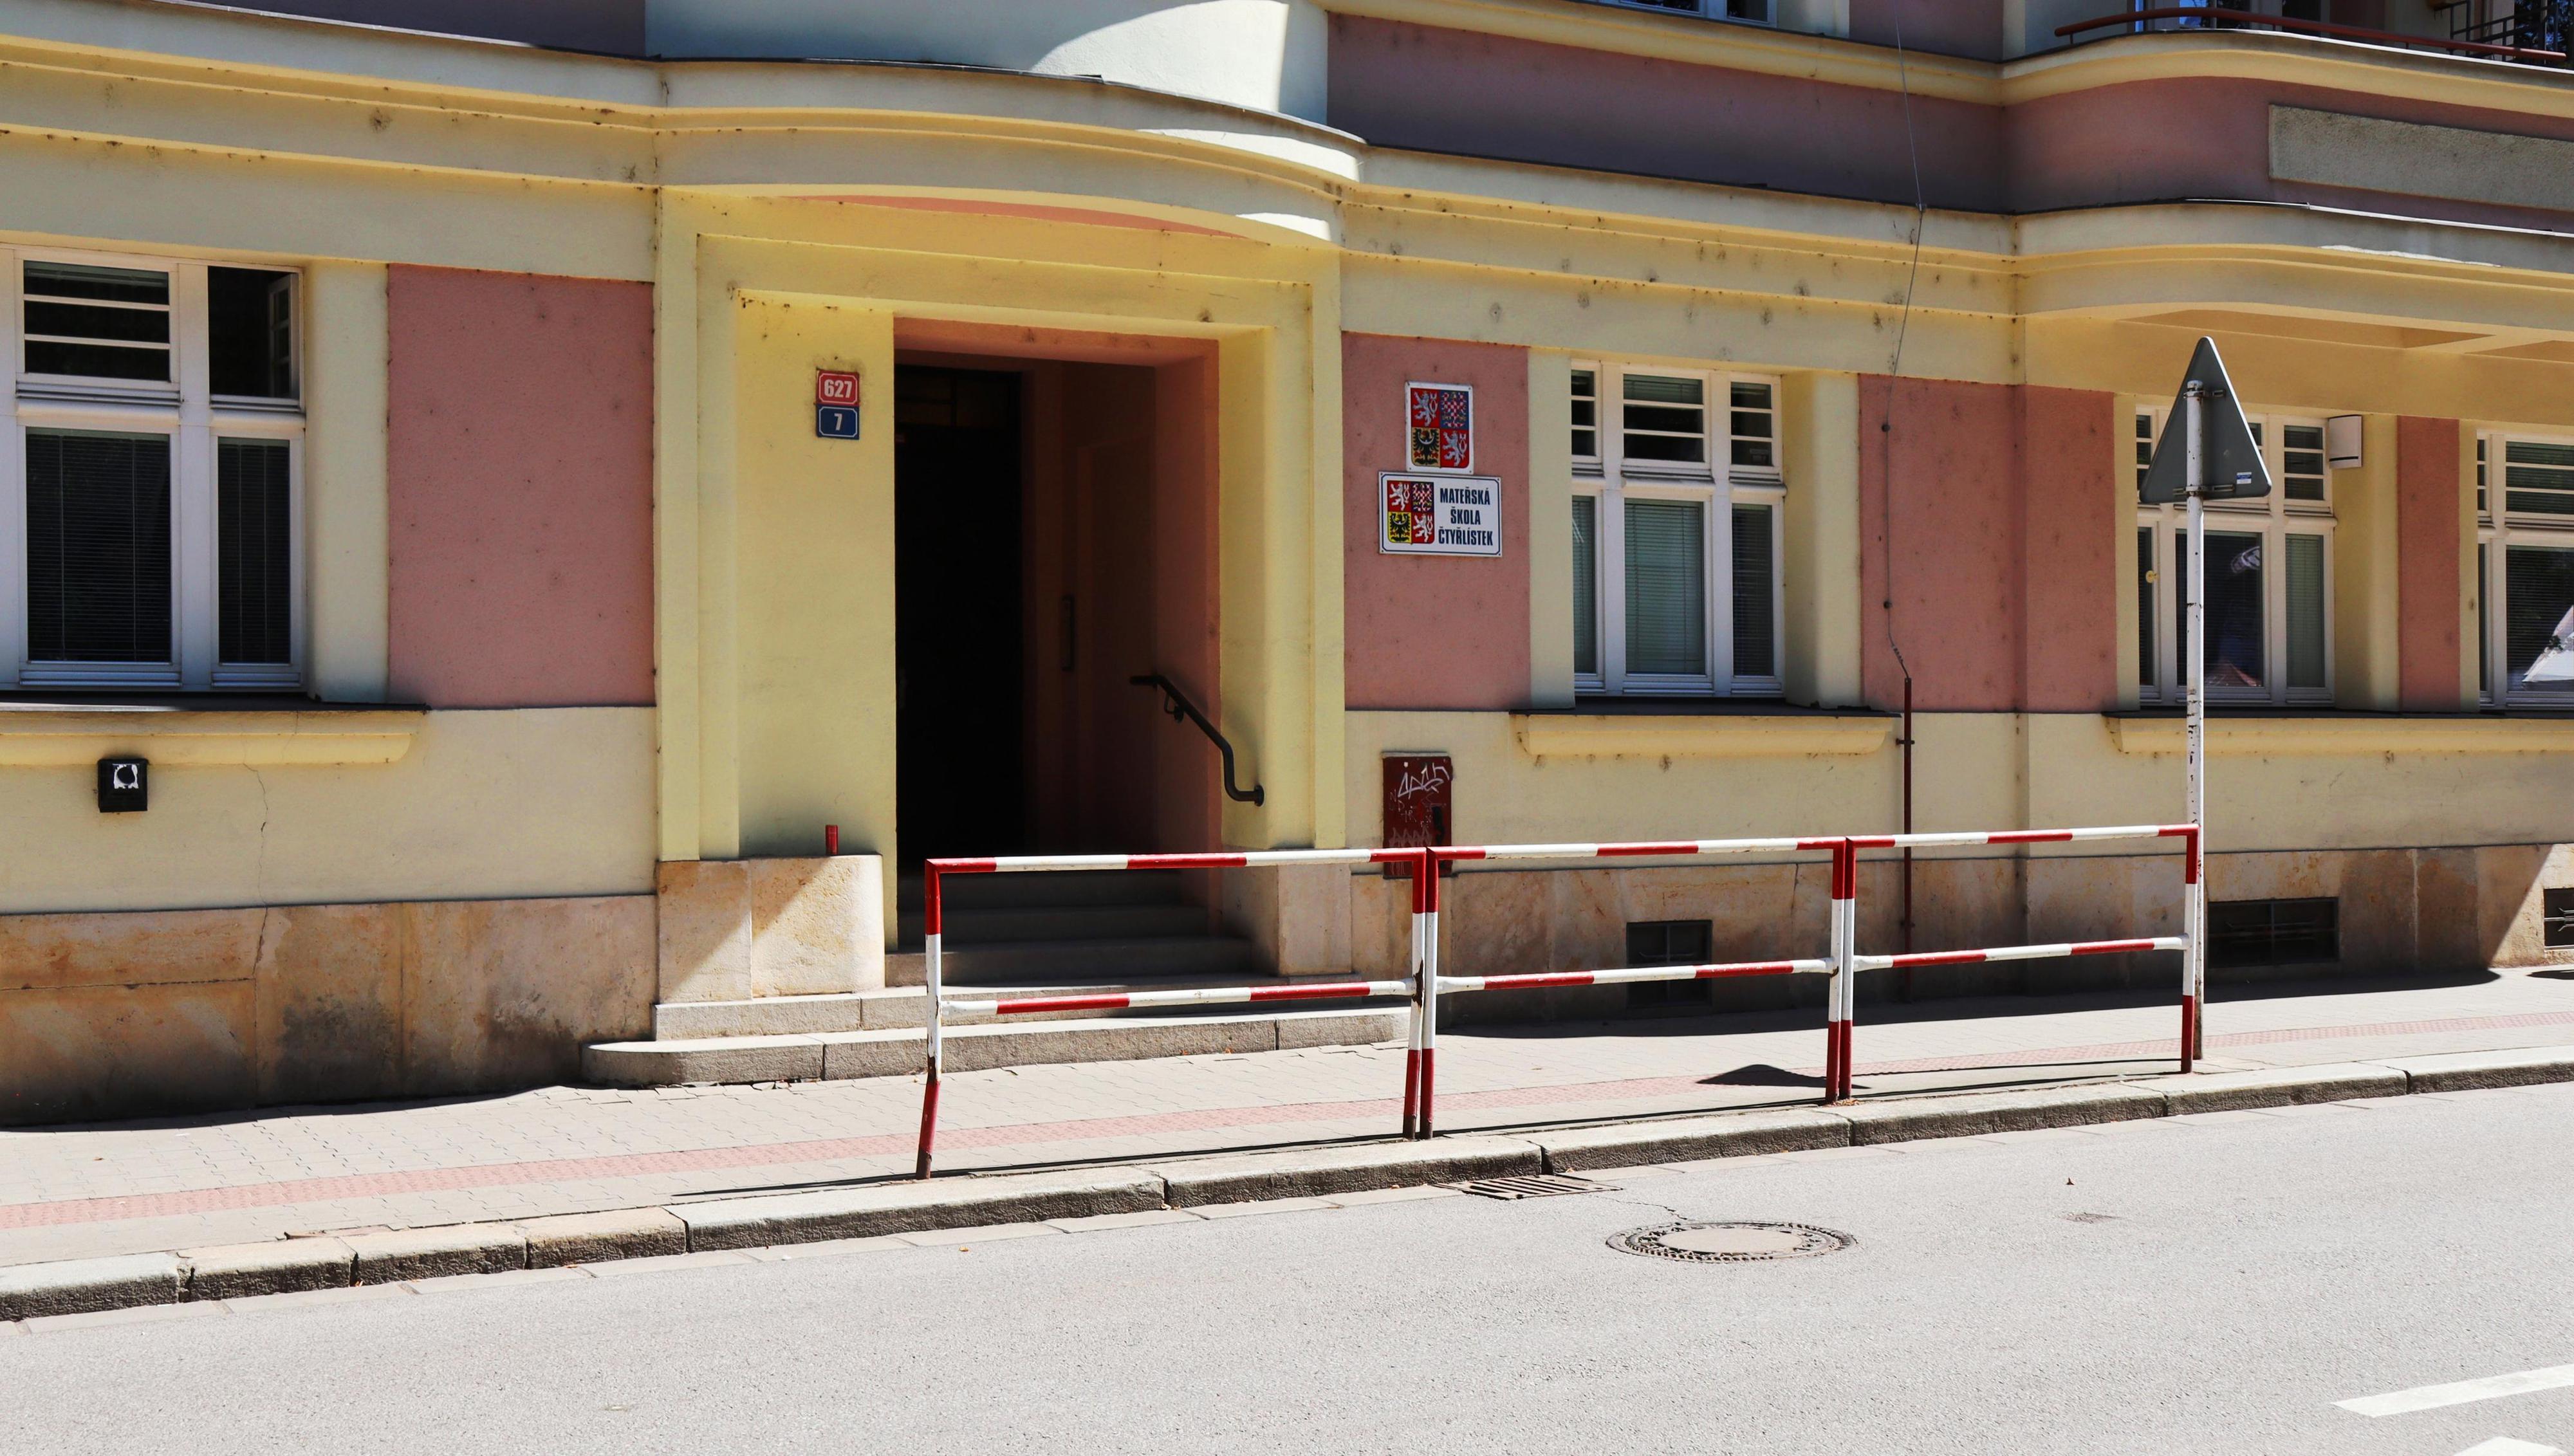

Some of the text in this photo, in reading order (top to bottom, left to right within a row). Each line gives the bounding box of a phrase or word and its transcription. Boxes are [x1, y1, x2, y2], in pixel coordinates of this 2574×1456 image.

[824, 380, 852, 398] 627
[834, 413, 842, 430] 7
[1440, 486, 1490, 505] MATEŘSKÁ
[1450, 506, 1481, 525] ŠKOLA
[1438, 527, 1493, 546] ČTYŘLÍSTEK
